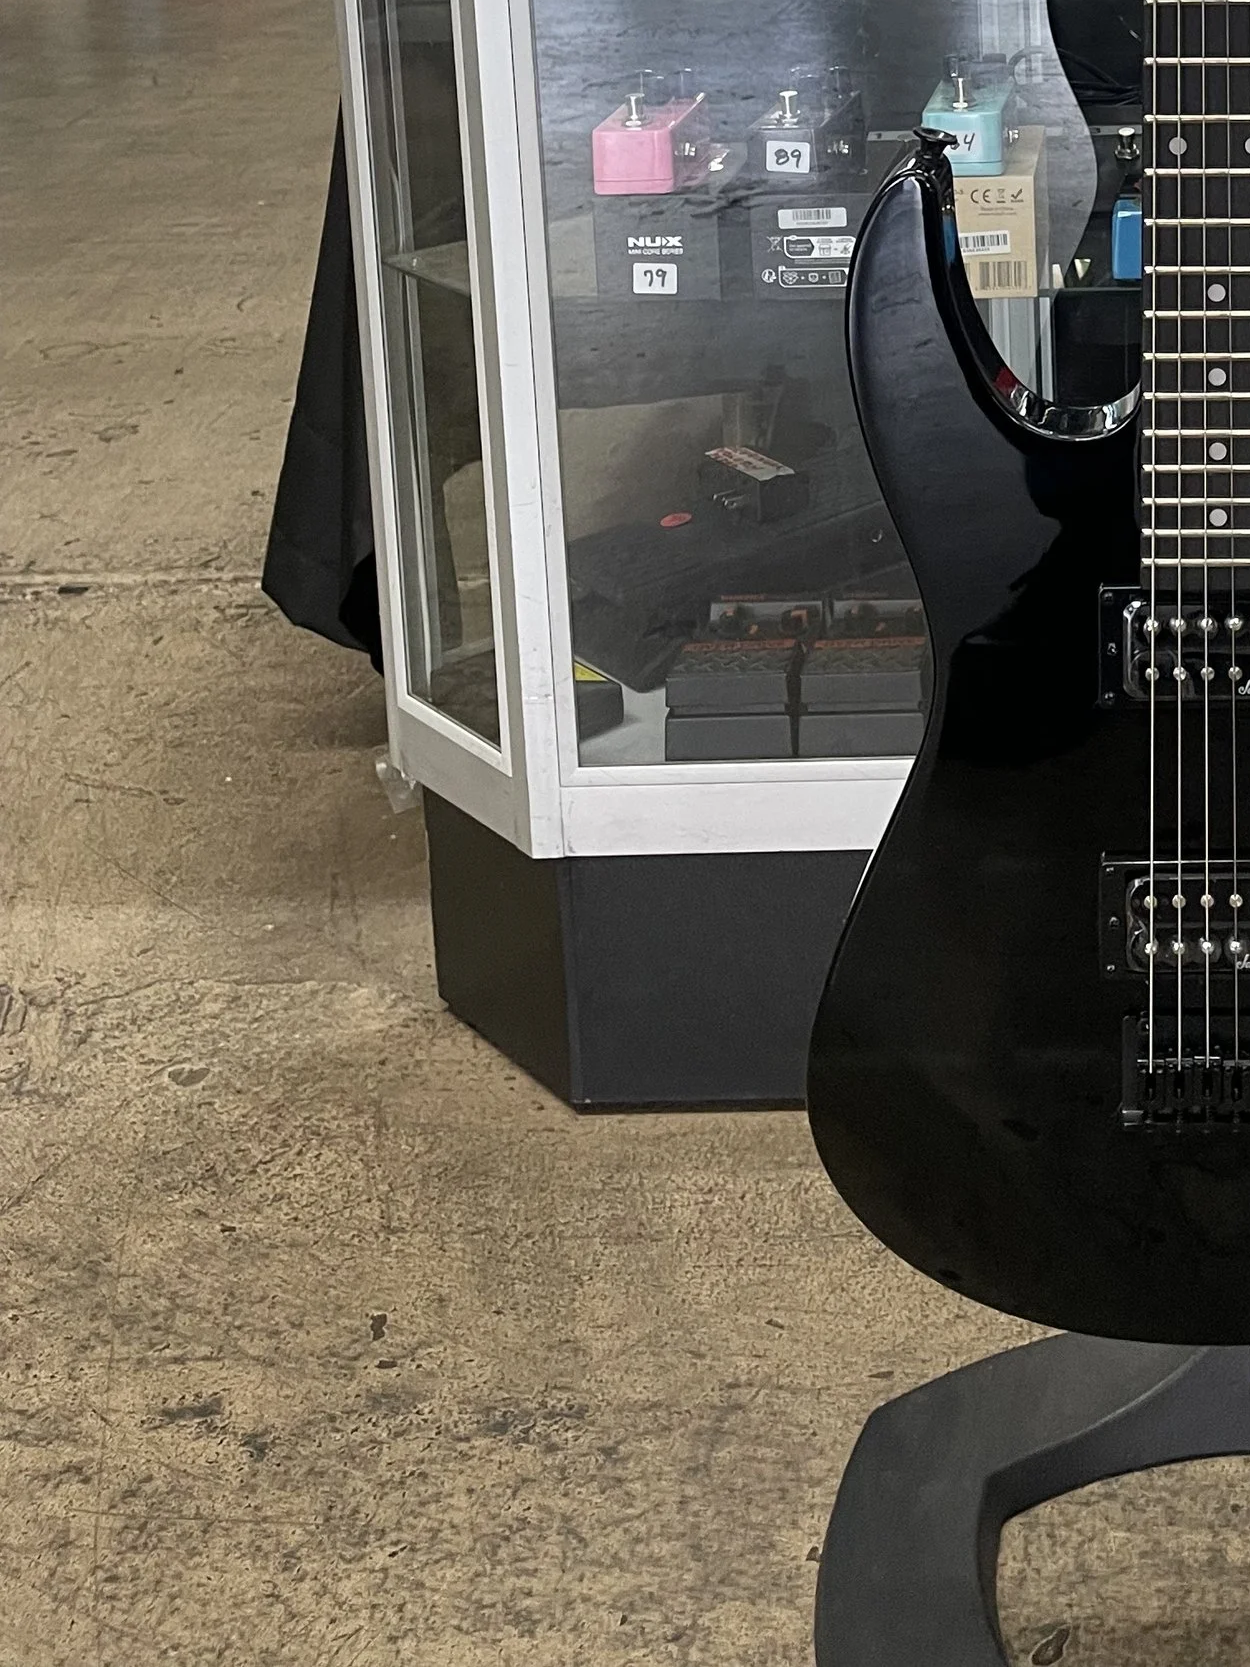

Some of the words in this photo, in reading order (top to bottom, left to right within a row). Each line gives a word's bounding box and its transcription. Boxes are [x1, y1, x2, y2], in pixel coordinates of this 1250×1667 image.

[773, 148, 802, 169] 89
[627, 236, 684, 248] NUX
[643, 268, 668, 288] 79
